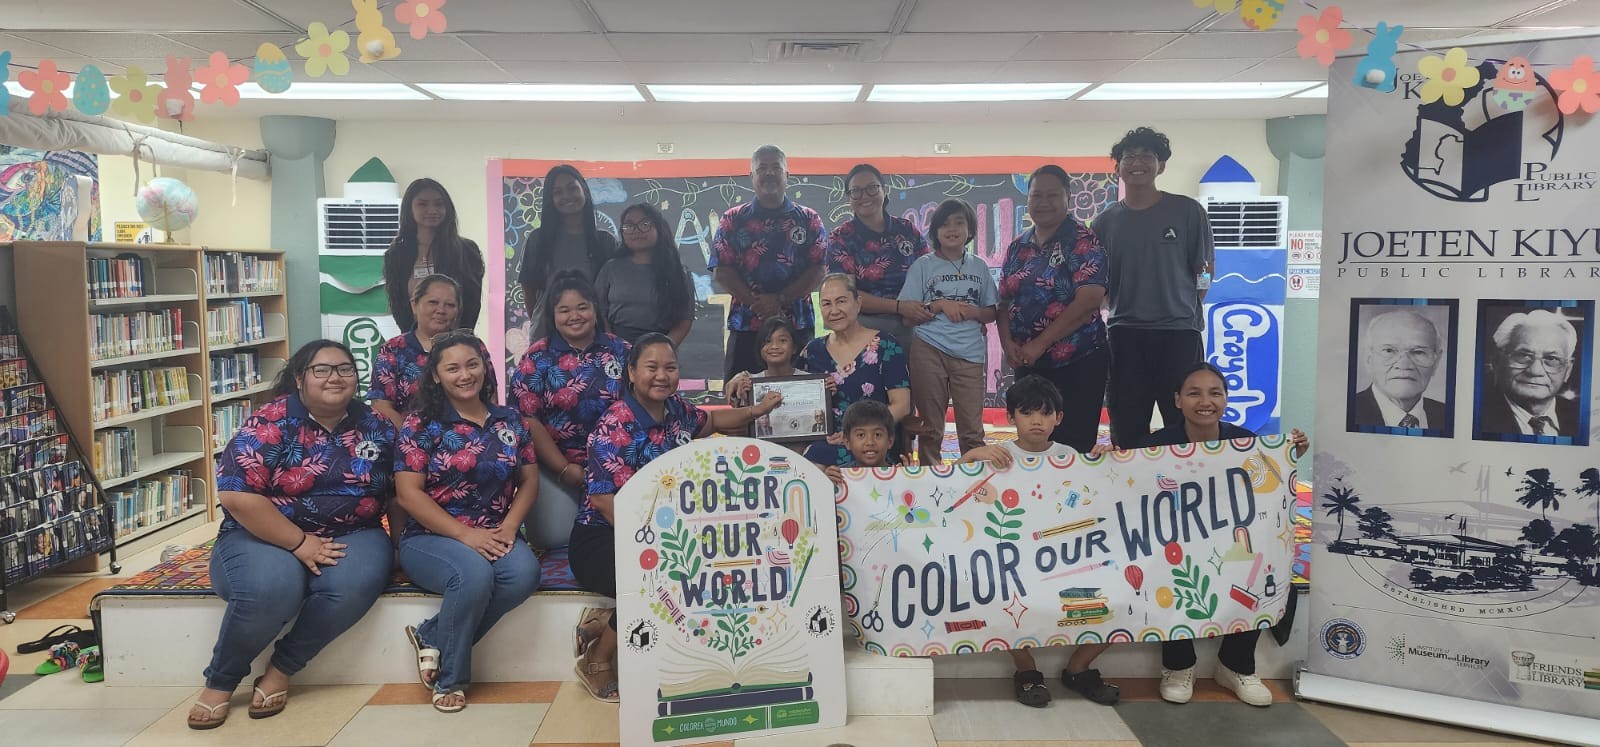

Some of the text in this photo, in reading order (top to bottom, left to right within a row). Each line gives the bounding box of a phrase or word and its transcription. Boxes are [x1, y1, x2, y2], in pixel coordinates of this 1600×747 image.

[1522, 162, 1597, 181] PUBLIC
[1514, 181, 1596, 201] LIBRARY
[1291, 239, 1303, 250] NO
[1337, 229, 1497, 264] JOETEN
[1337, 266, 1600, 278] PUBLIC LIBRAR
[1209, 308, 1263, 422] Crayola
[679, 475, 780, 515] COLOR
[701, 522, 762, 559] OUR
[891, 542, 1026, 628] COLOR
[1035, 530, 1110, 573] OUR
[1116, 466, 1256, 561] WORLD
[680, 566, 788, 607] WORLD
[1383, 584, 1528, 614] ESTABLISHED MCMXCI
[1408, 647, 1490, 667] Museum Library
[1532, 662, 1582, 676] FRIENDS
[1532, 671, 1585, 688] LIBRARY
